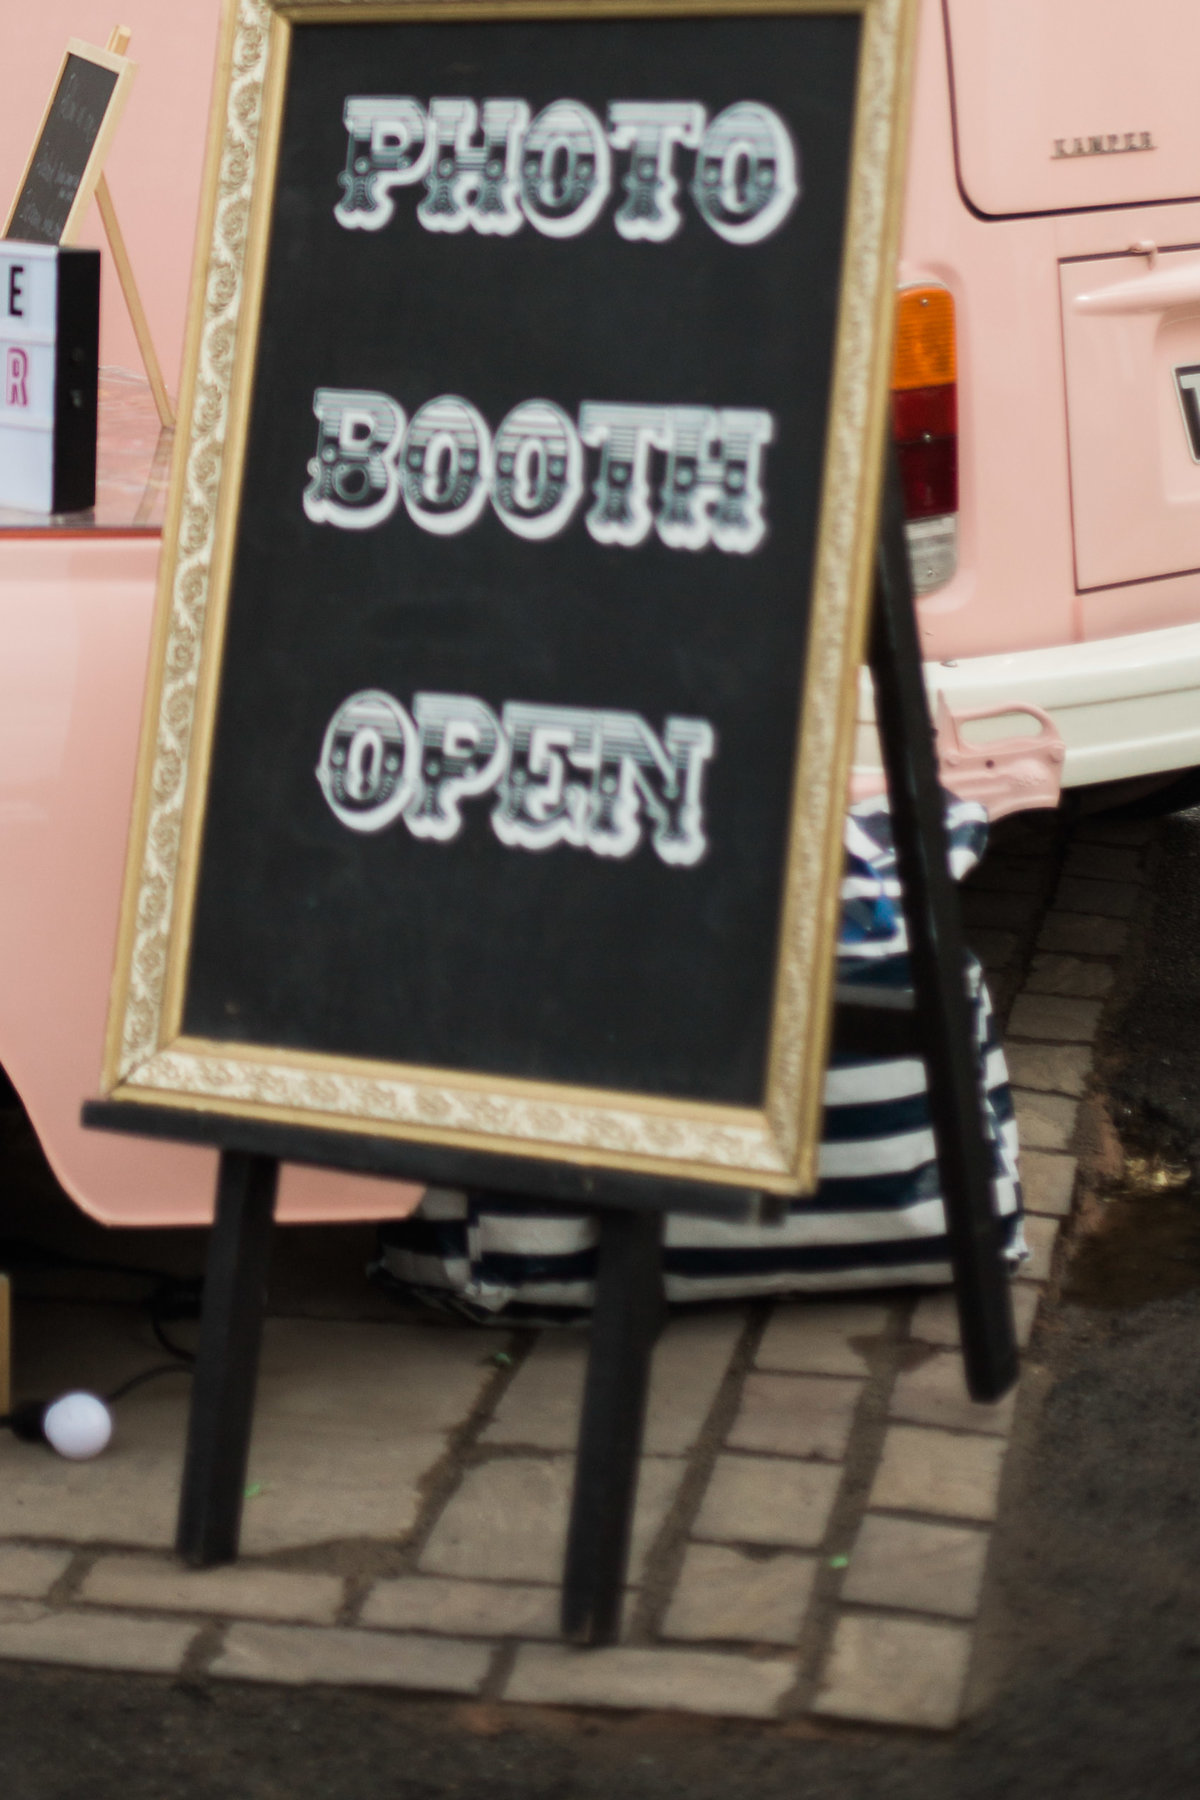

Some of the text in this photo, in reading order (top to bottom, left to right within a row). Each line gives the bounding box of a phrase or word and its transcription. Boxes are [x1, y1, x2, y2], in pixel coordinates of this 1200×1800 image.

[333, 95, 798, 246] PHOTO
[303, 387, 774, 555] BOOTH
[316, 689, 714, 867] OPEN
